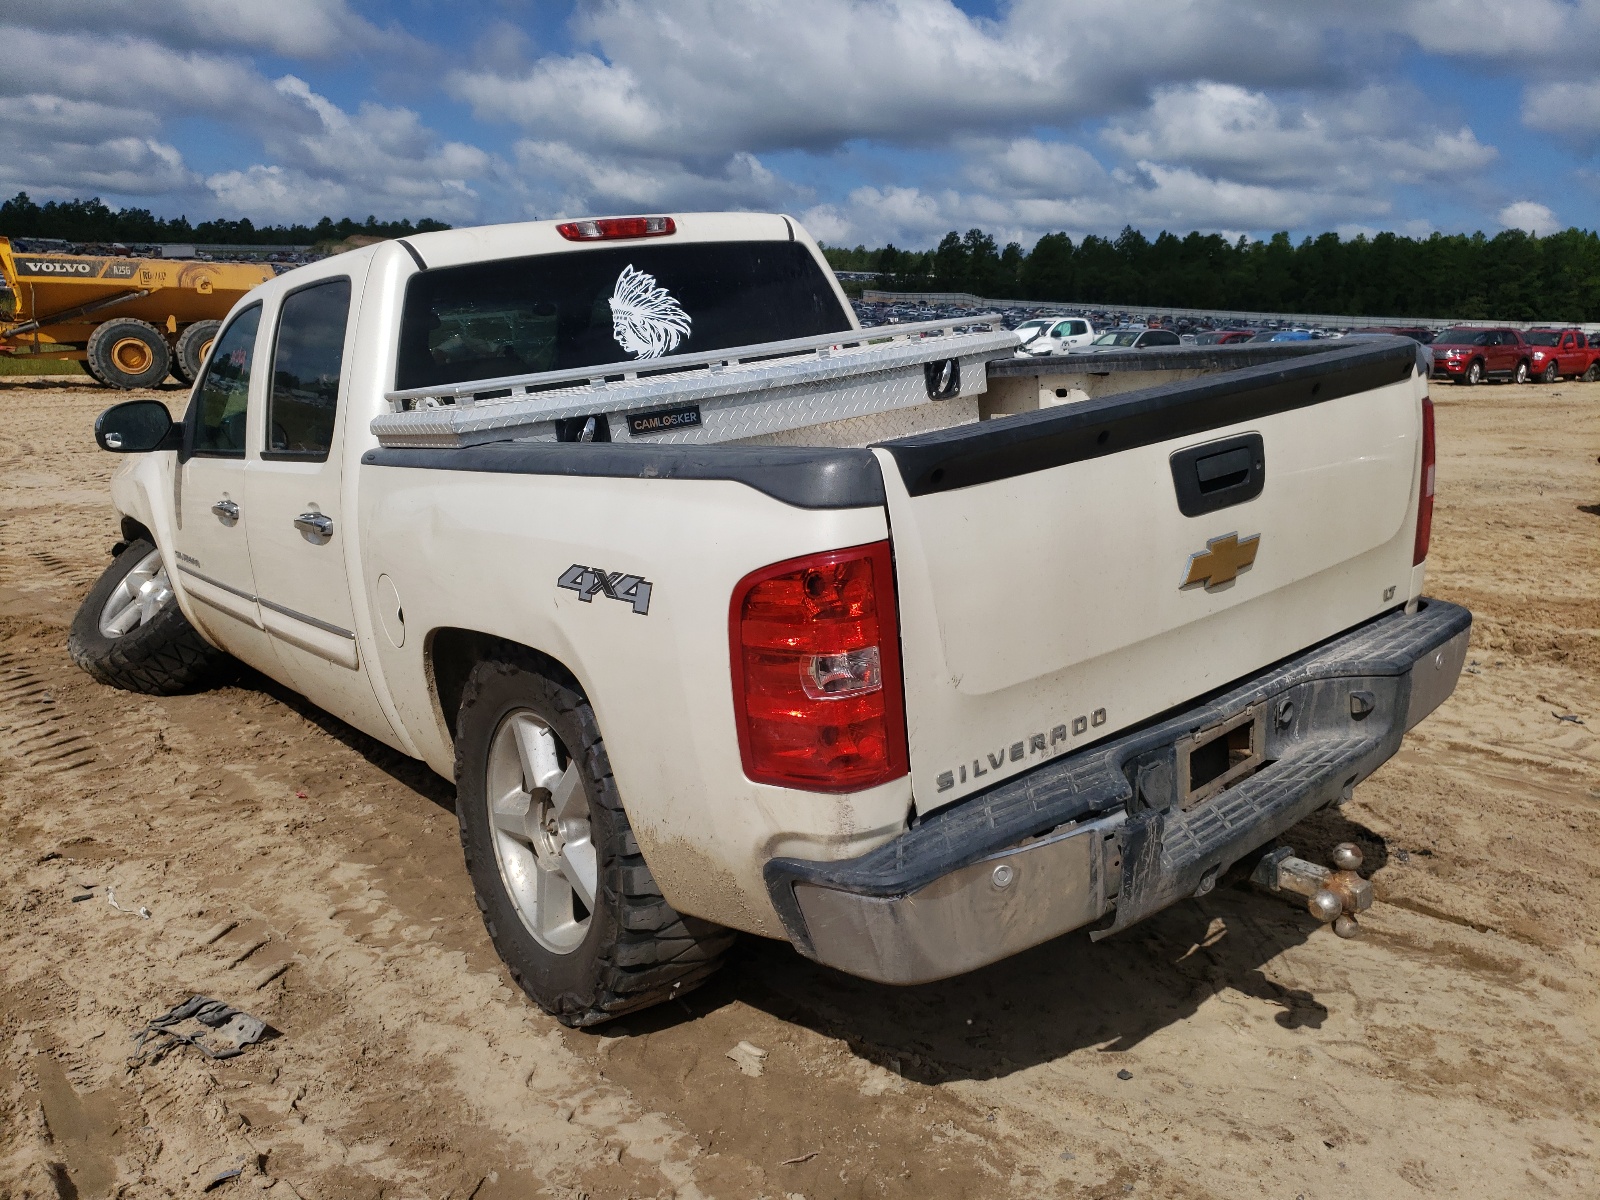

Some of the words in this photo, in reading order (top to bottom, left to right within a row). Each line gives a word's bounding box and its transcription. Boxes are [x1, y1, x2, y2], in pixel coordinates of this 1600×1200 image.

[25, 262, 91, 273] VOLVO
[634, 412, 697, 430] CAMLOCKER
[1382, 585, 1397, 603] LT
[936, 707, 1107, 793] SILVERADO
